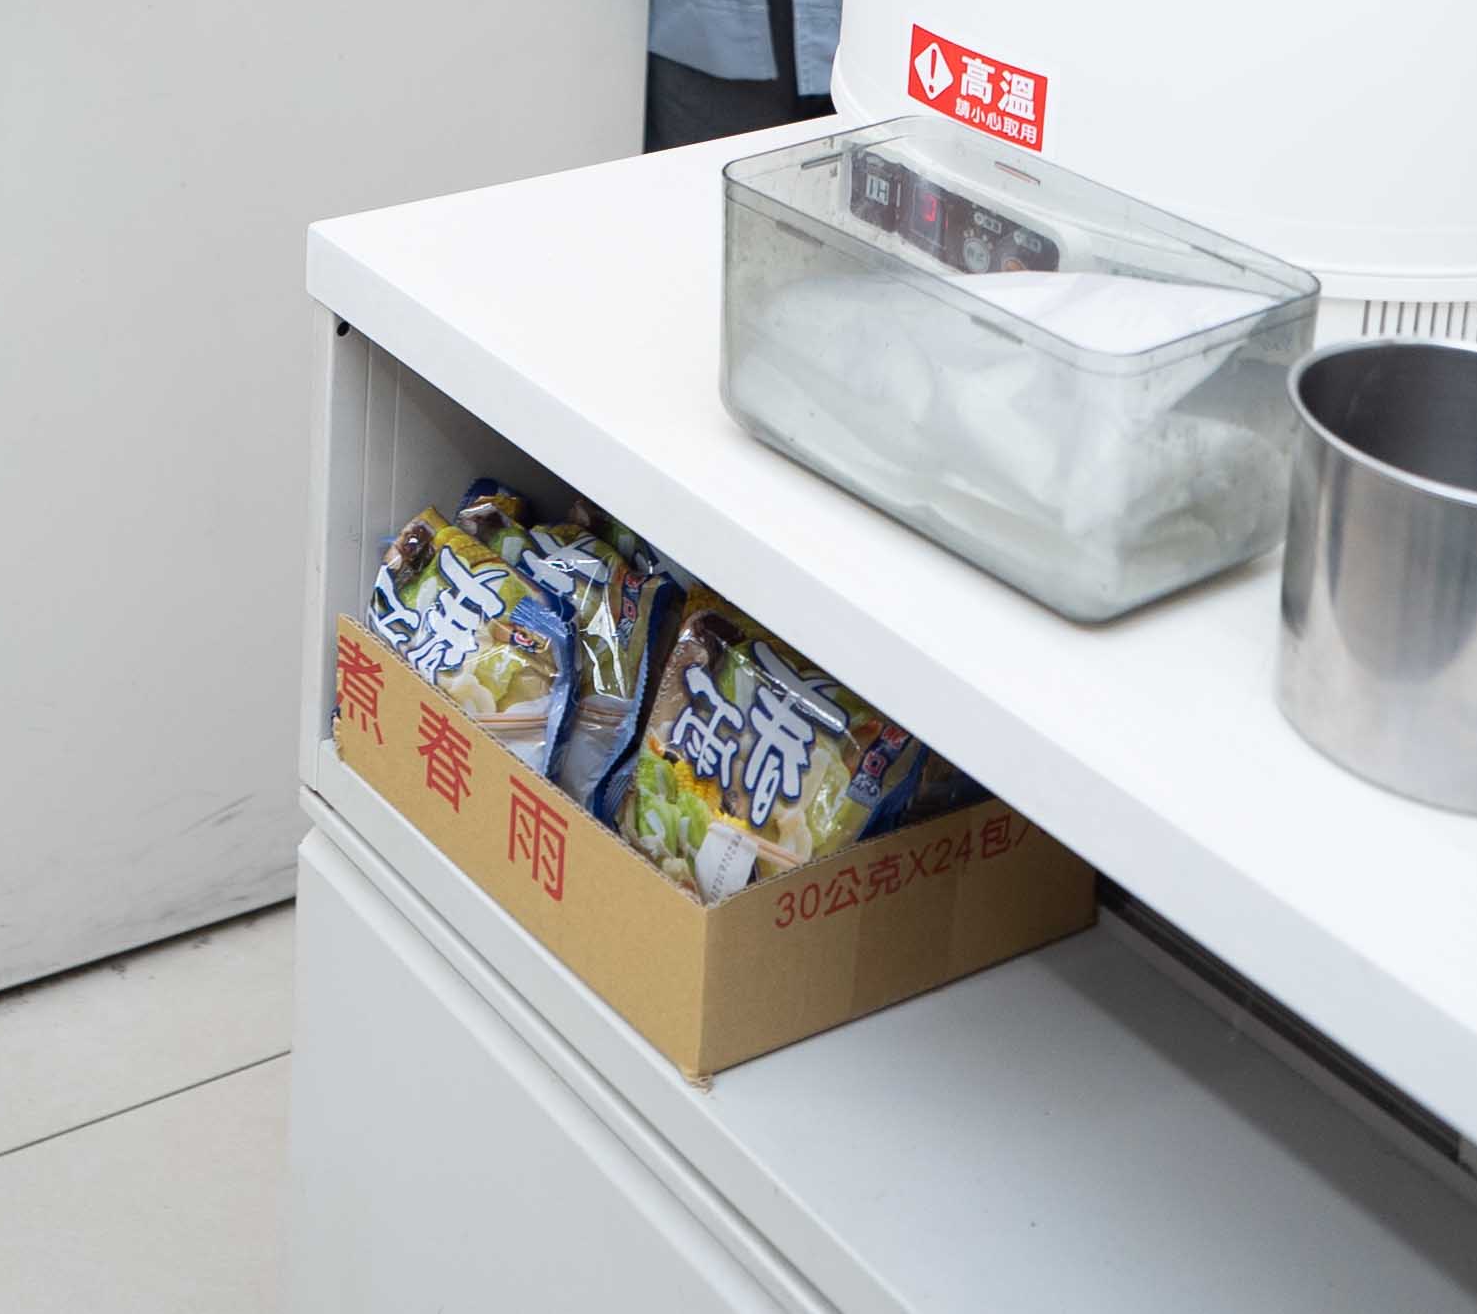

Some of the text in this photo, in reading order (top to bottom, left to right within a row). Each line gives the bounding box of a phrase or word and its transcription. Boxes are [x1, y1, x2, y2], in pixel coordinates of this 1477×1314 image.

[955, 97, 1038, 145] 請小心取用
[961, 54, 1036, 122] 高溫
[337, 634, 569, 902] 煮春雨
